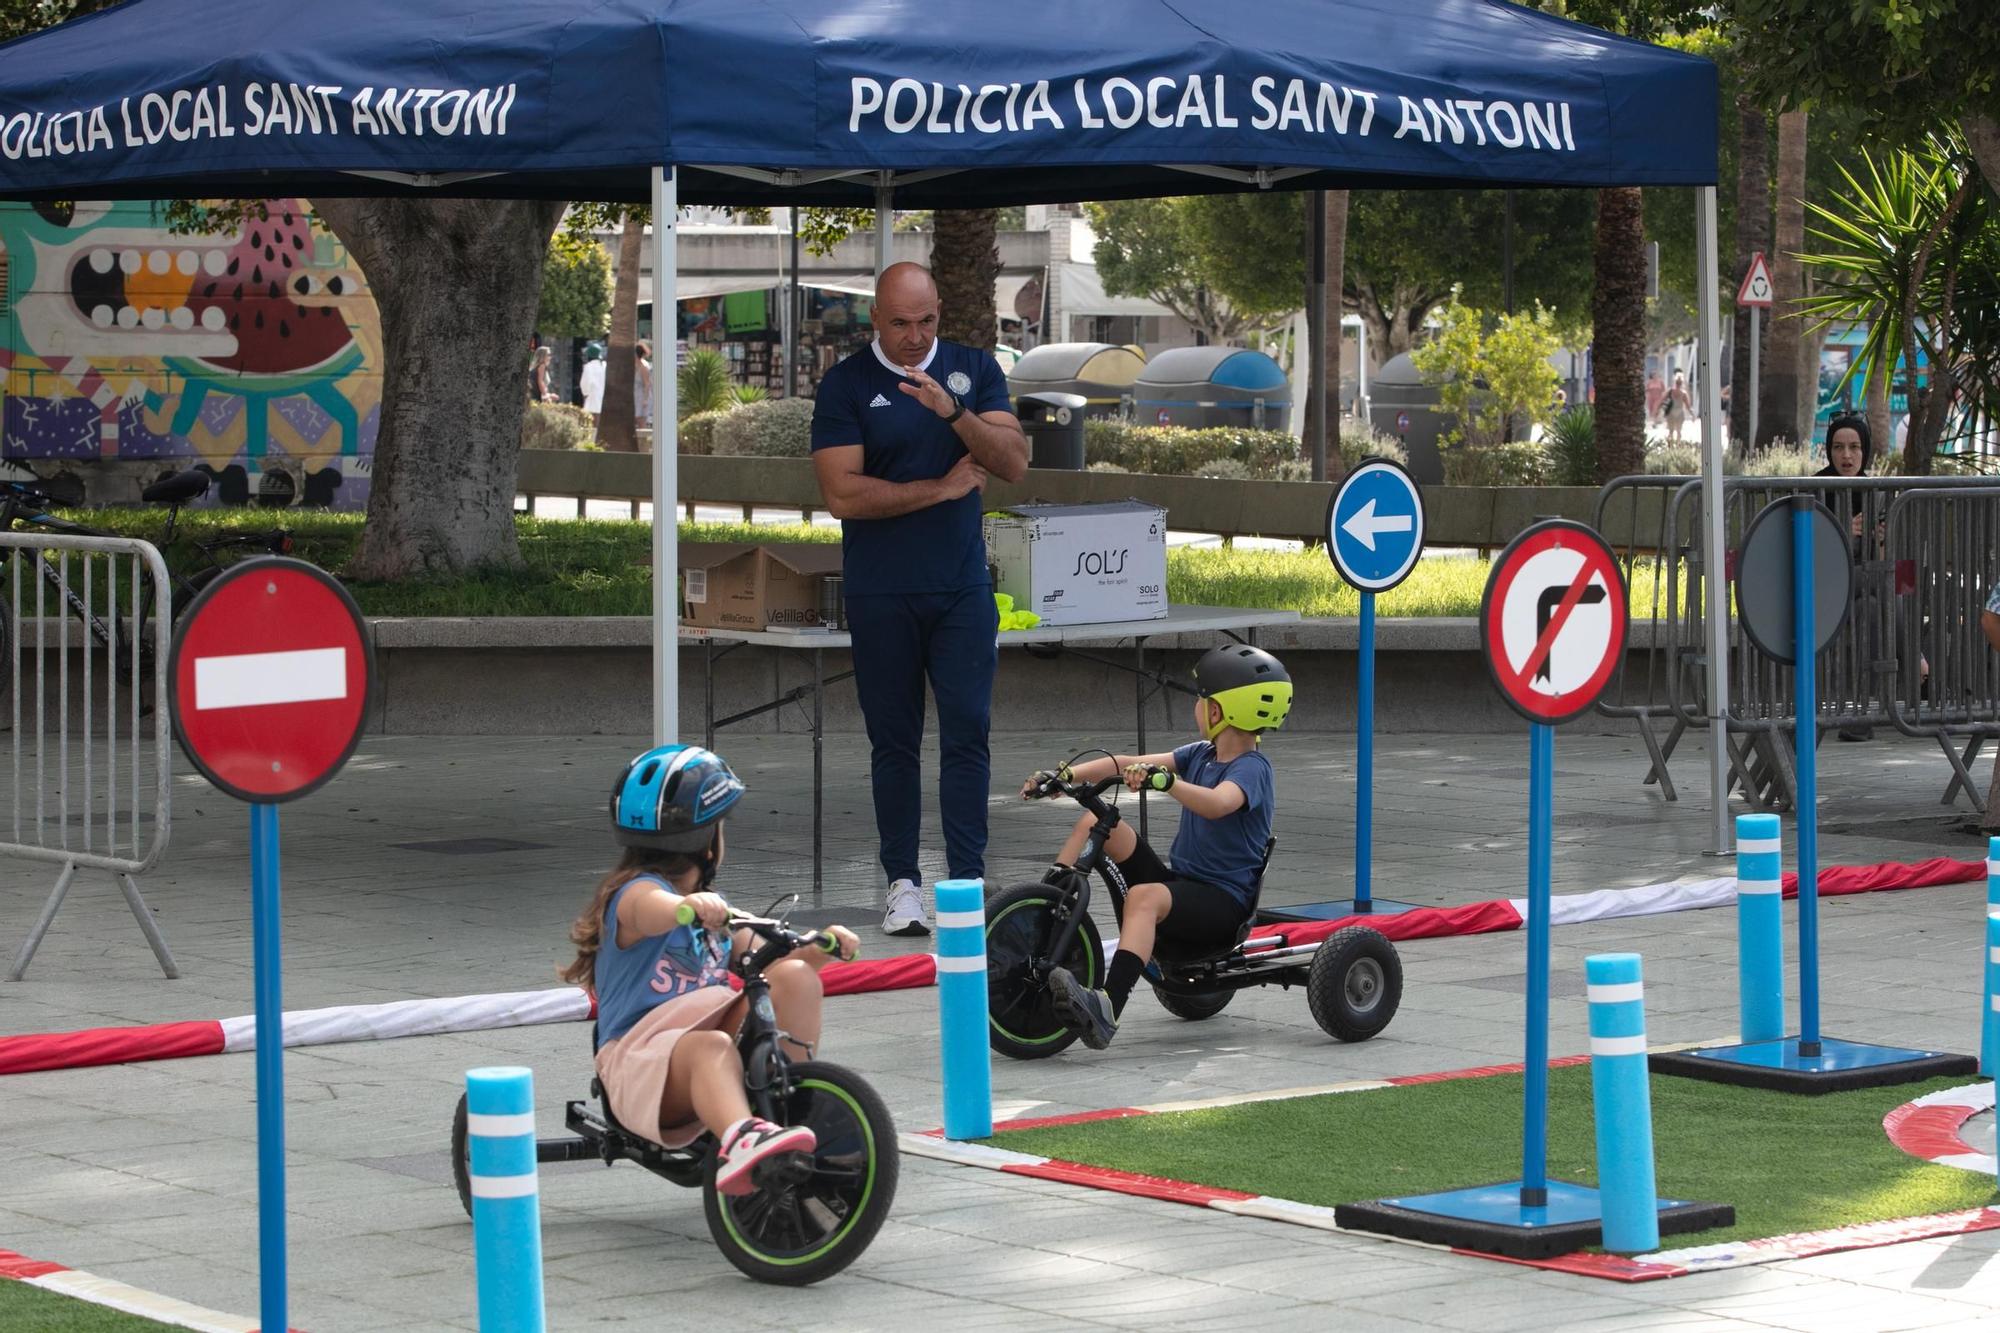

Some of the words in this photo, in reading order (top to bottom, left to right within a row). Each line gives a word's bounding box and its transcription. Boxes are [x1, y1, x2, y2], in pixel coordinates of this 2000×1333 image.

[121, 85, 235, 147] LOCAL
[244, 82, 343, 136] SANT
[351, 83, 516, 137] ANTONI
[849, 77, 1064, 134] POLICIA
[1074, 74, 1239, 129] LOCAL
[1251, 76, 1380, 137] SANT
[1393, 95, 1576, 151] ANTONI
[869, 400, 892, 408] adidas
[1073, 549, 1128, 576] SOL'S
[1139, 585, 1159, 593] SOLO
